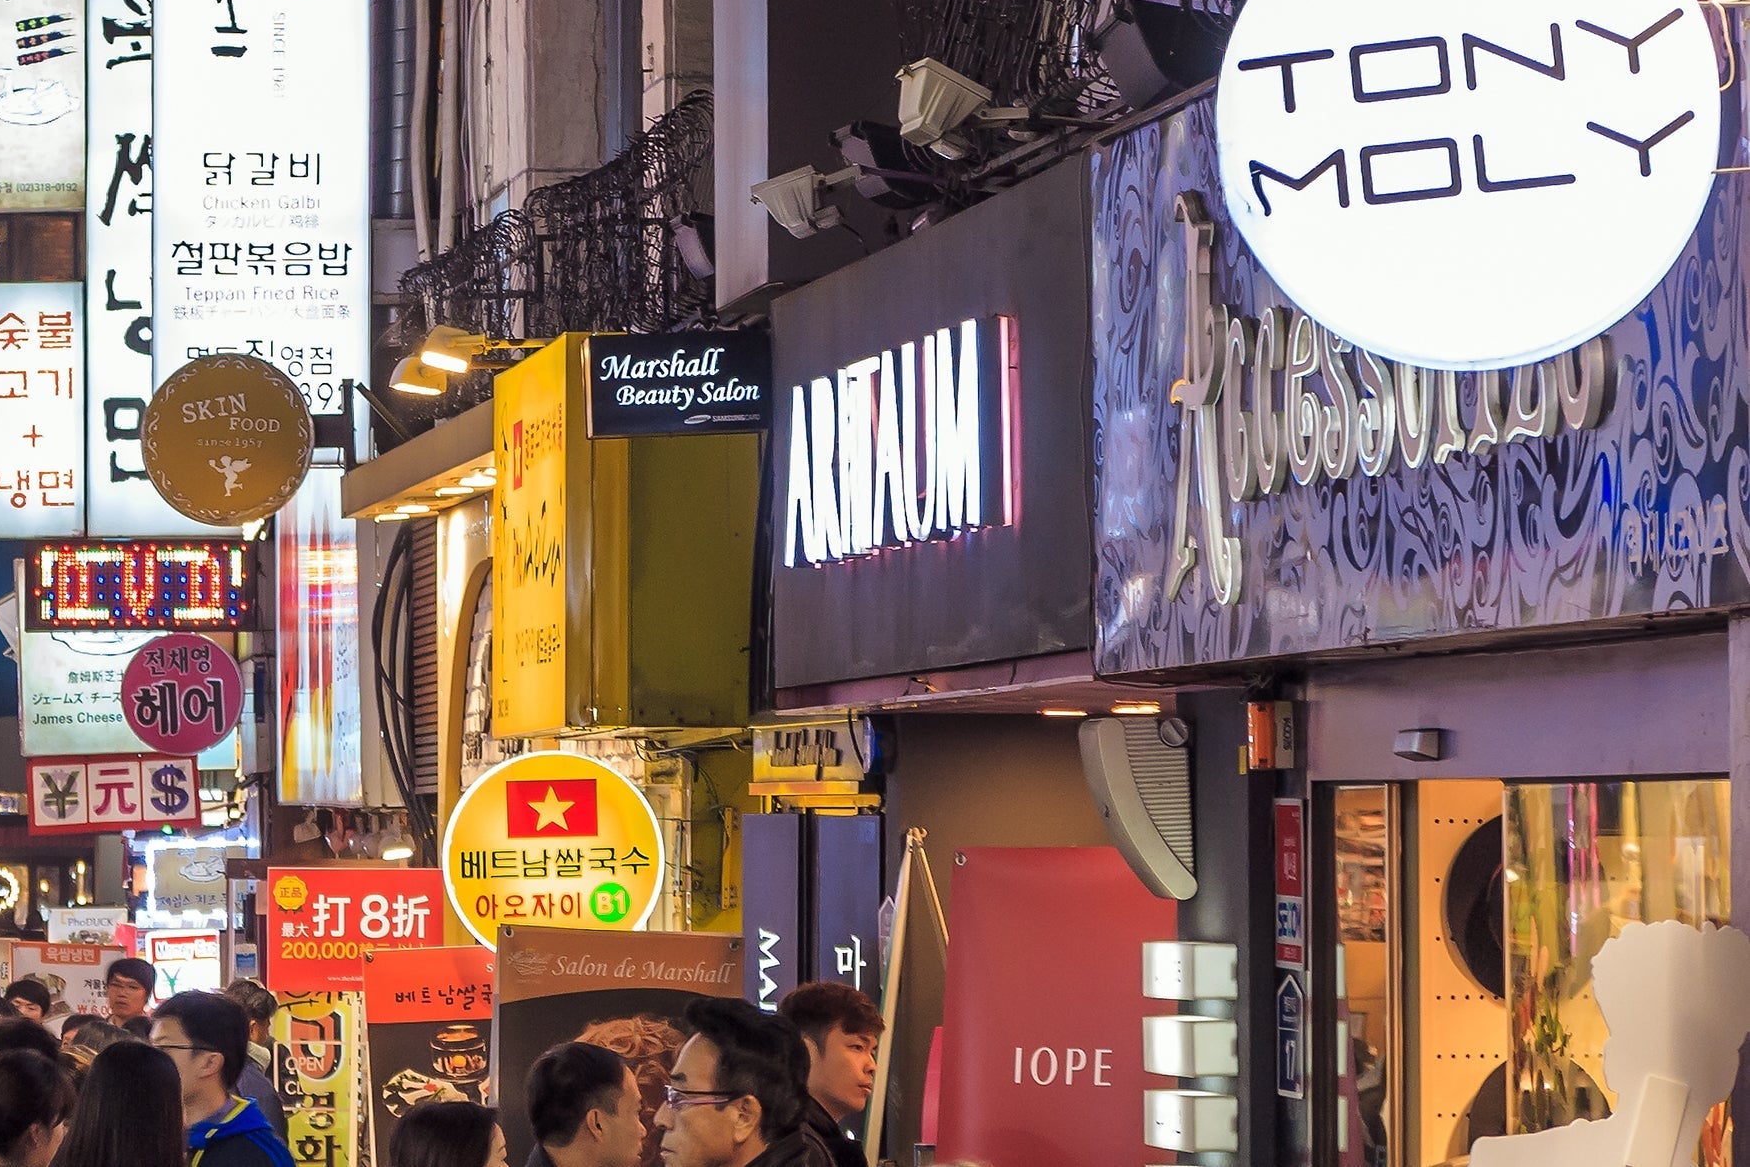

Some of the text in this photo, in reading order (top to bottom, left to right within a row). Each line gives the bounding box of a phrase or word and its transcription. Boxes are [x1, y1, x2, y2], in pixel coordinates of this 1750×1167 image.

[1237, 8, 1684, 114] TONY
[202, 152, 321, 186] 닭갈비
[1248, 110, 1696, 217] MOLY
[16, 182, 78, 194] (02)318-0192
[202, 194, 321, 211] Chicken Galbi
[170, 240, 353, 276] 철판볶음밥
[185, 284, 340, 302] Teppan Fried Rice
[600, 347, 725, 382] Marshall
[182, 392, 248, 424] SKIN
[615, 378, 761, 411] Beauty Salon
[229, 417, 282, 433] FOOD
[144, 645, 210, 675] 전채영
[32, 711, 123, 725] James Cheese
[133, 679, 225, 736] 헤어
[94, 768, 137, 816] 元
[150, 763, 189, 816] $
[460, 846, 651, 880] 베트남쌀국수
[475, 889, 627, 920] 아오자이 B1
[67, 916, 115, 928] PhoDUCK
[280, 921, 311, 939] 最大
[46, 944, 96, 963] 육쌈냉면
[551, 954, 737, 984] Salon de Marshall
[1013, 1045, 1114, 1088] IOPE
